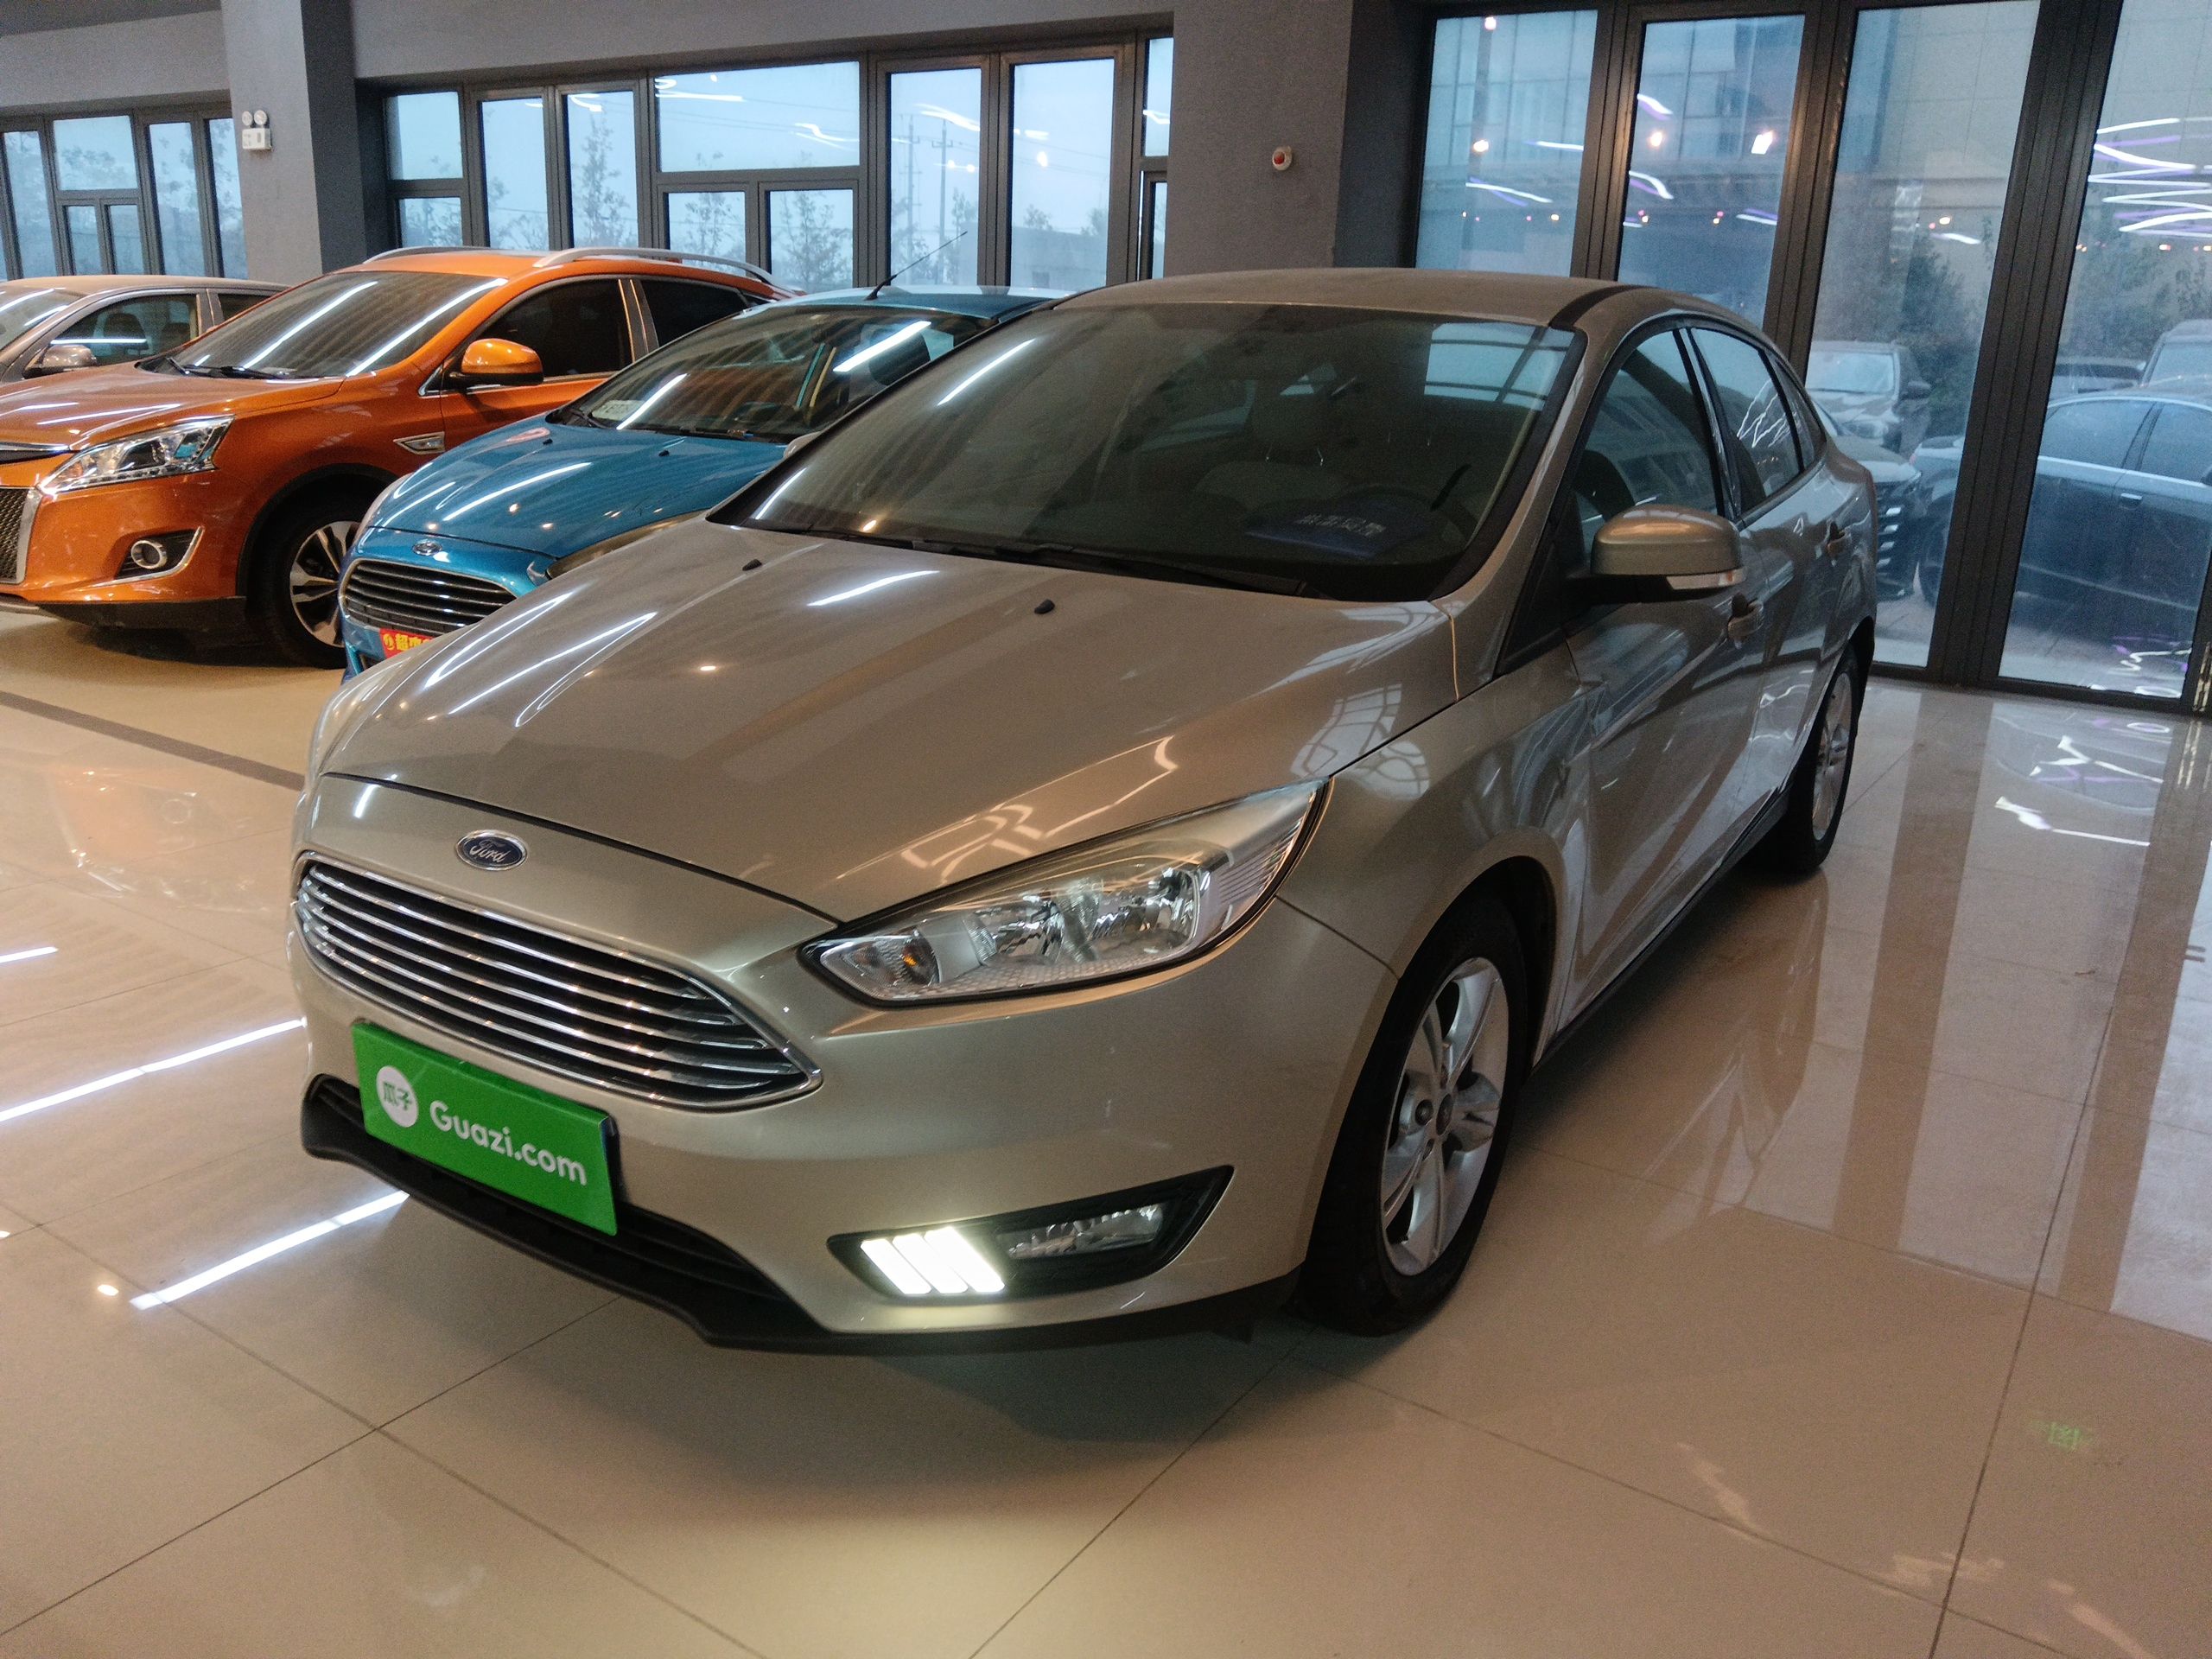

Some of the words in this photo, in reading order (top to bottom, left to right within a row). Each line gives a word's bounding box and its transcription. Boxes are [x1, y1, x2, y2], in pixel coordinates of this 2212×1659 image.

[469, 839, 512, 863] Ford
[383, 1081, 414, 1112] 瓜子
[429, 1100, 588, 1186] Guazi.com
